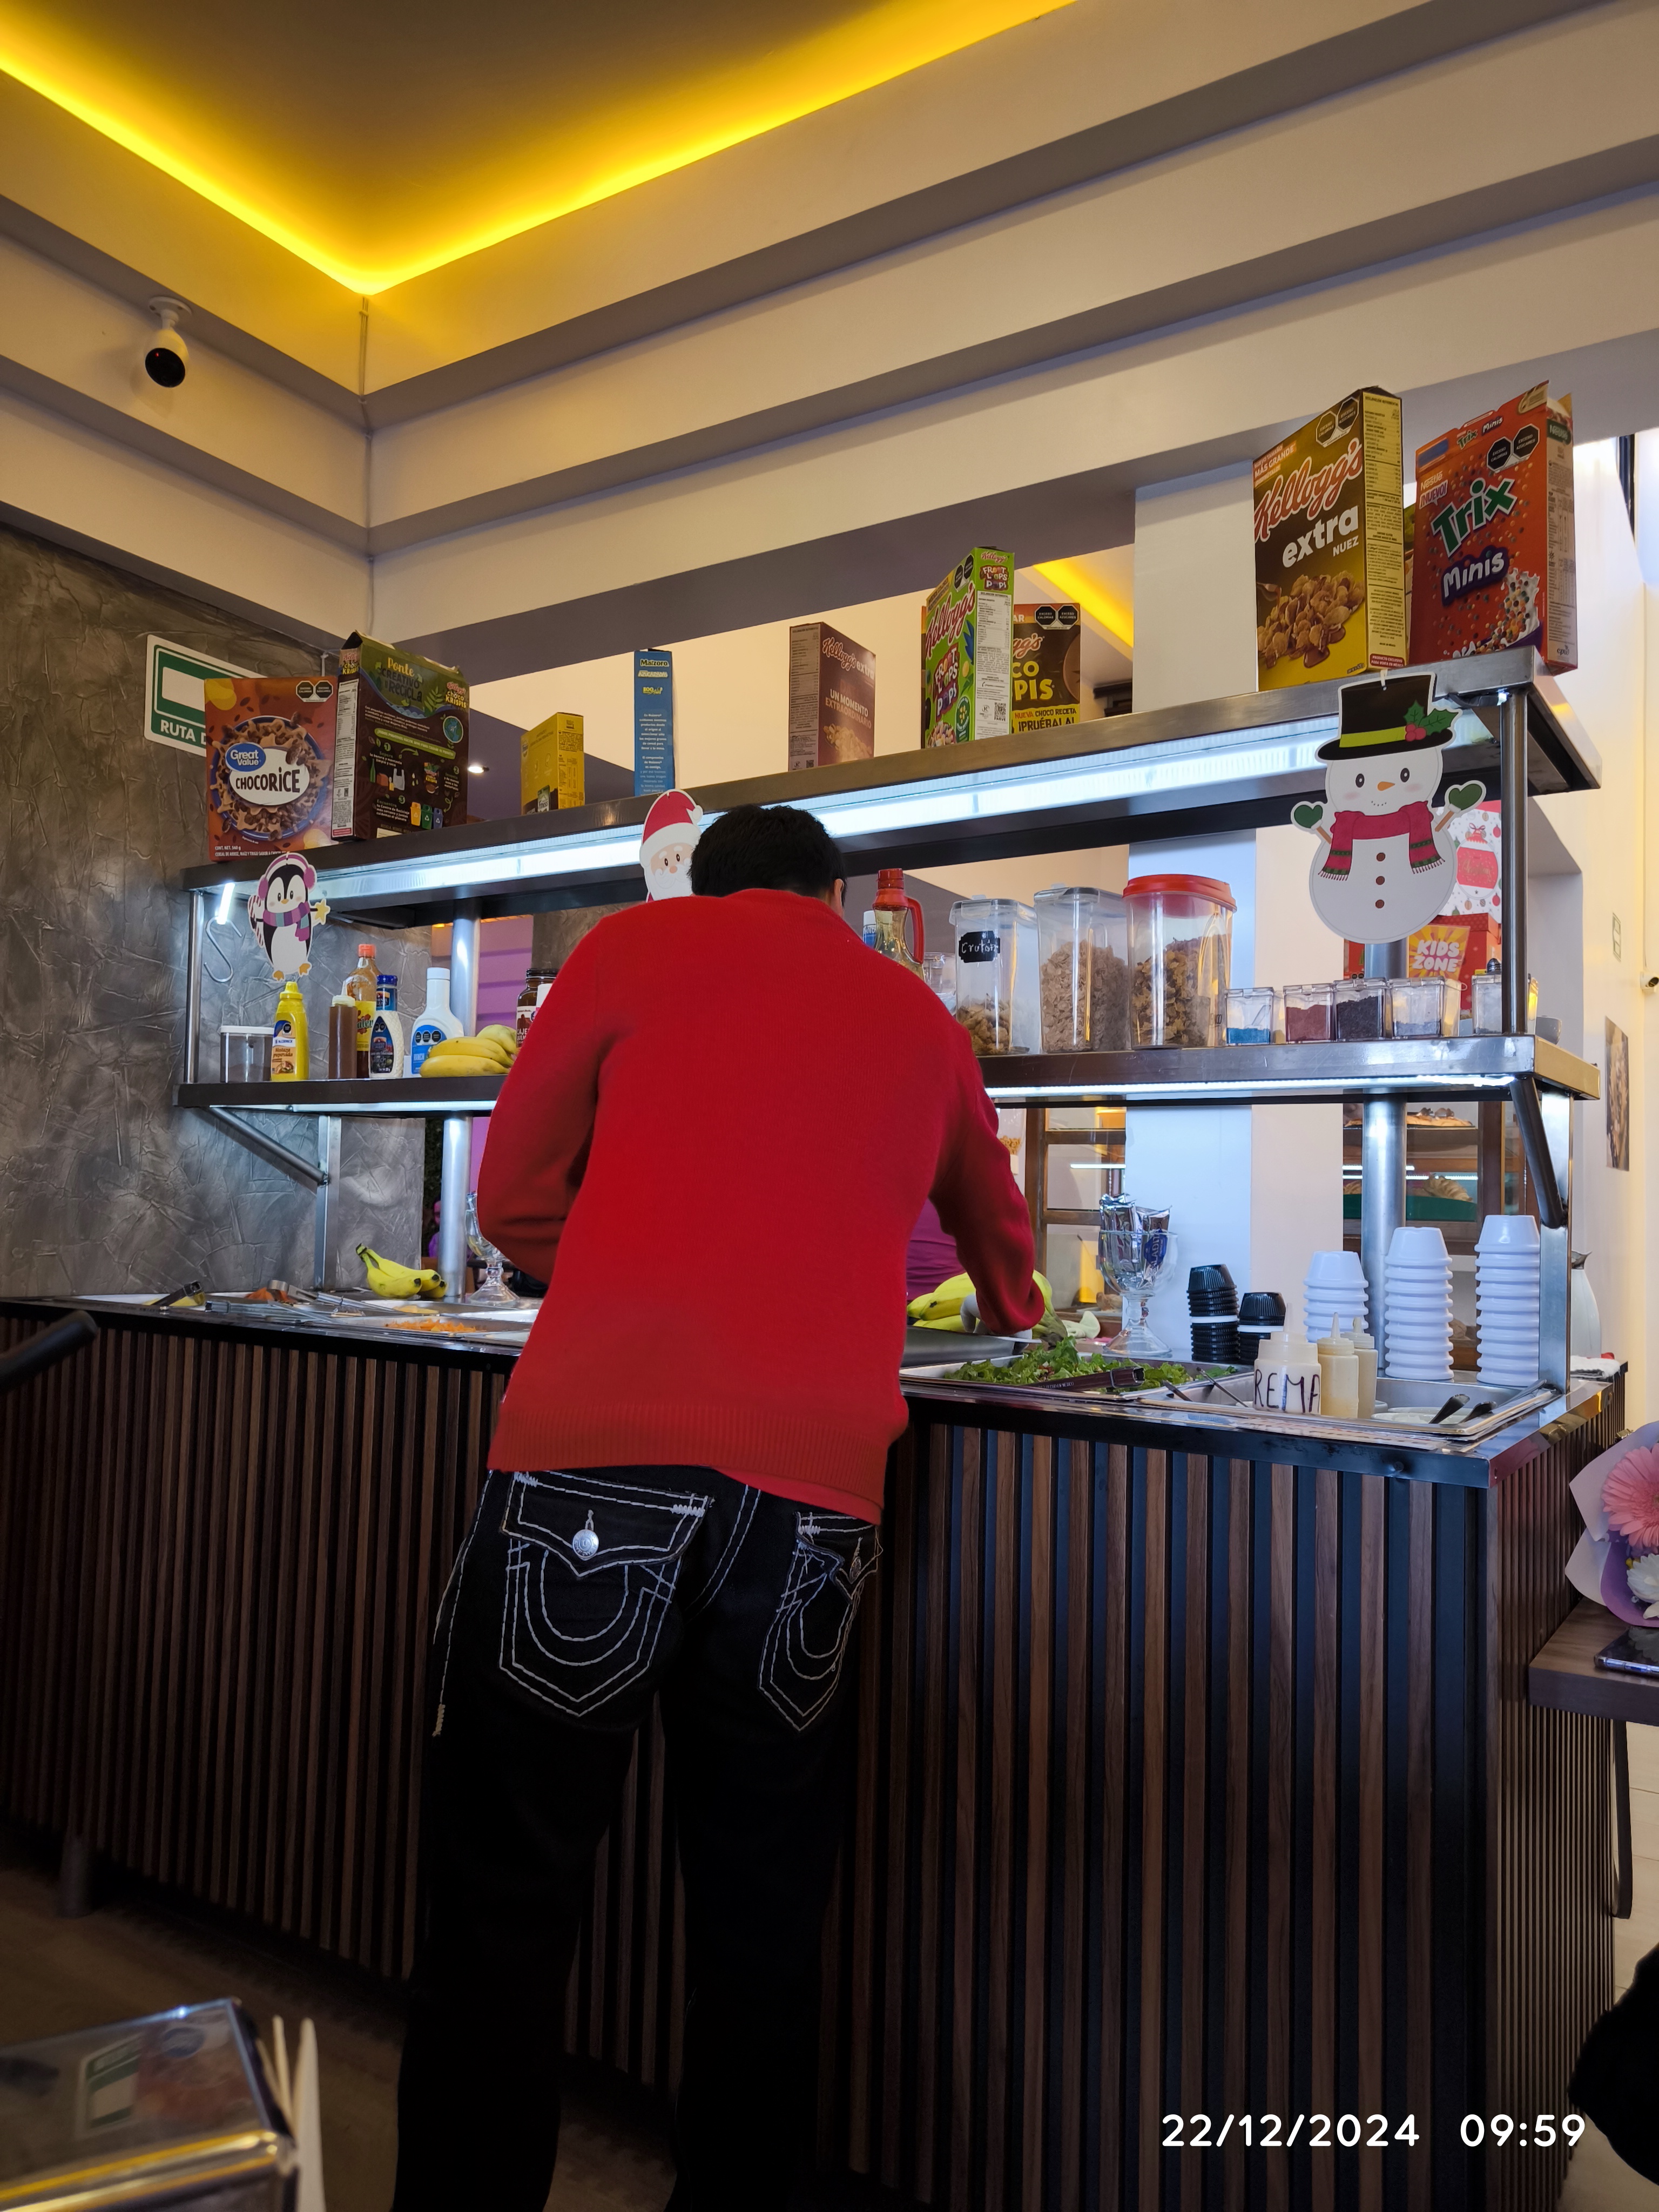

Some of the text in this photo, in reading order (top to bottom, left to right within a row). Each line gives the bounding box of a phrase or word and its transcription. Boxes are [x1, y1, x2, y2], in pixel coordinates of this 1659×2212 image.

[1482, 416, 1503, 434] Minis
[1253, 437, 1363, 542] Kellogg's
[1421, 471, 1444, 491] Nestlé
[1431, 477, 1518, 557] Trix
[1282, 505, 1359, 569] extra
[1332, 535, 1359, 557] NUEZ
[981, 551, 1007, 564] Kellogg's
[1445, 550, 1505, 597] Minis
[926, 581, 976, 660] Kellogg's
[388, 657, 415, 677] Ponte
[822, 637, 874, 680] Kellogg's extra
[446, 694, 467, 708] KRISPIS
[830, 689, 868, 717] UN MOMENTO
[826, 697, 872, 729] EXTRAORDINARIO
[1015, 707, 1077, 719] NUEVA CHOCO RECETA
[161, 719, 196, 742] RUTA
[230, 749, 259, 760] Great
[237, 758, 259, 766] Value
[1417, 939, 1460, 957] KIDS
[1412, 956, 1458, 973] ZONE
